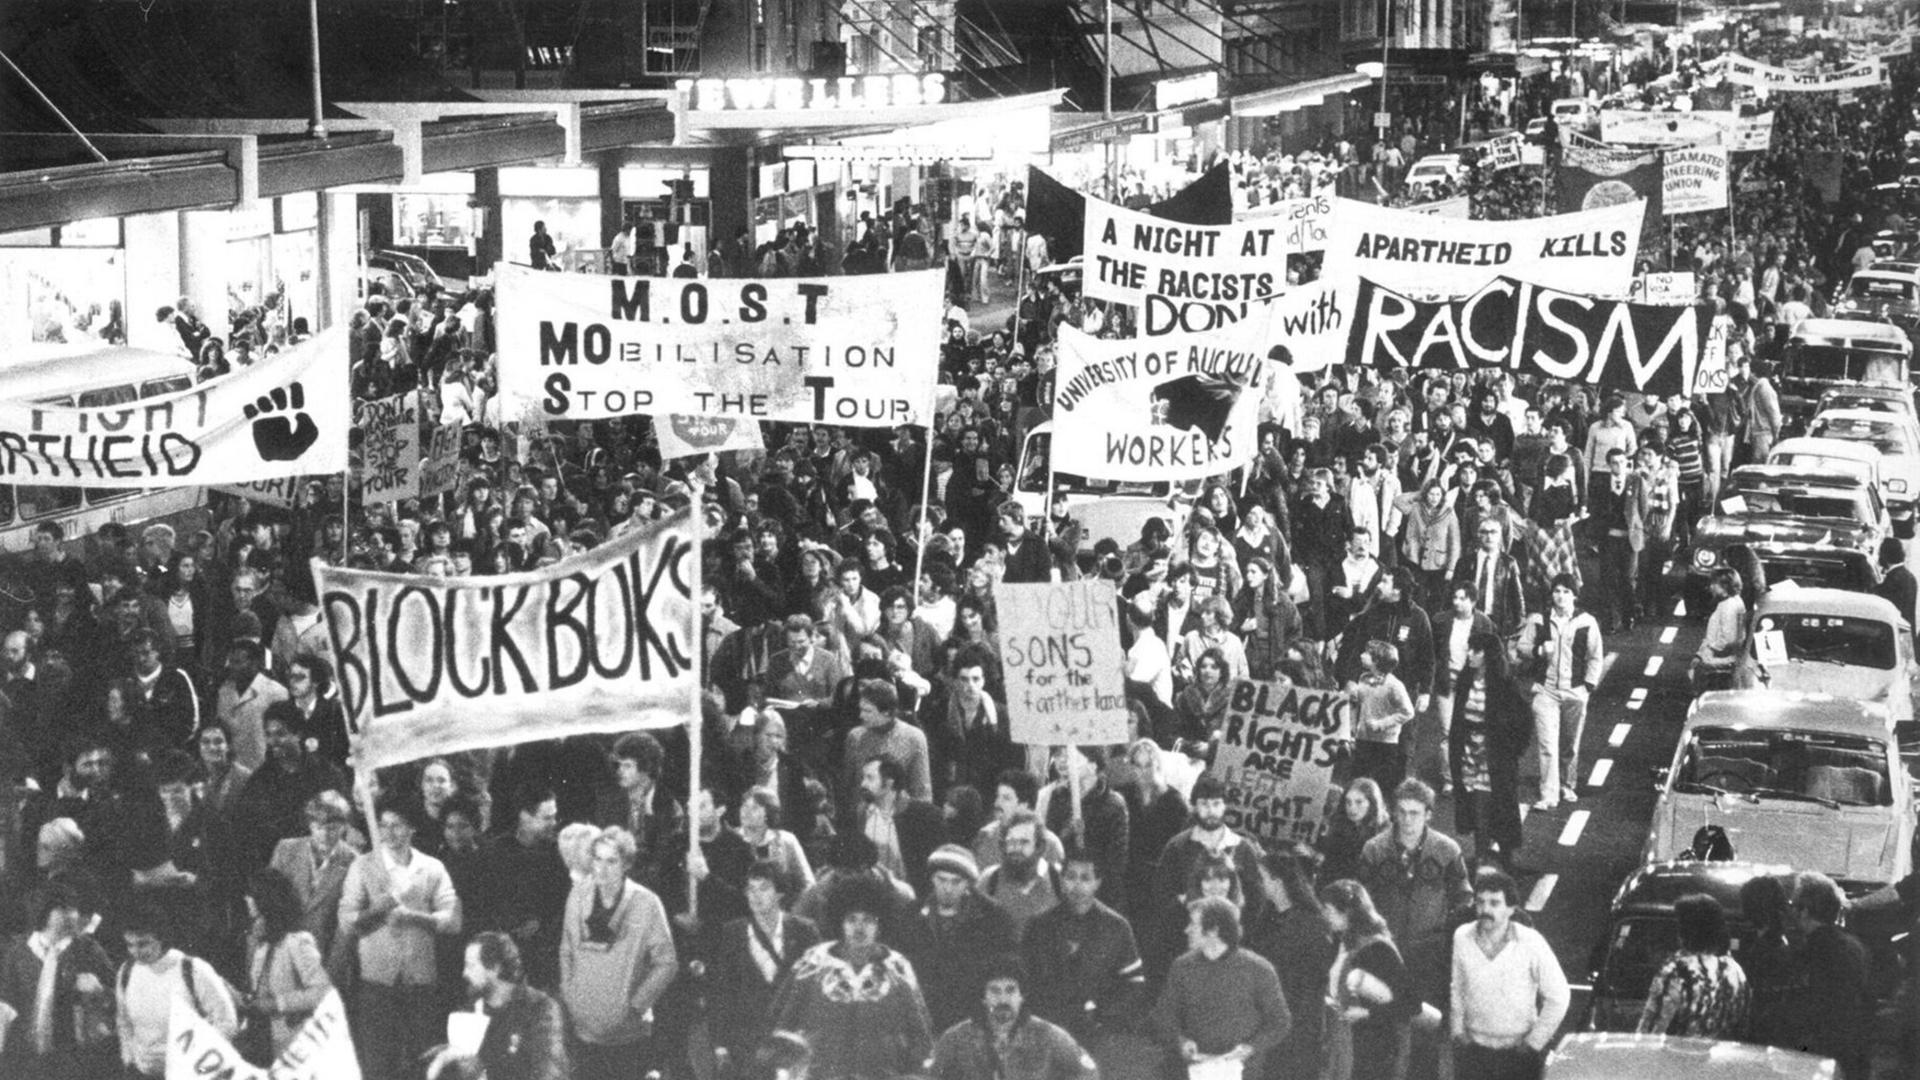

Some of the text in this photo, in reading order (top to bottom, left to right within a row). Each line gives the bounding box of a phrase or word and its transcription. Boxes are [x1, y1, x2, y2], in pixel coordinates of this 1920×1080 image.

[1764, 71, 1786, 82] PLAY
[1793, 74, 1819, 84] WITH
[1665, 179, 1702, 192] UNION
[1102, 218, 1275, 257] A NIGHT AT
[1355, 230, 1627, 266] APARTHEID KILLS
[1096, 254, 1273, 300] THE RACISTS
[1283, 289, 1341, 336] with
[540, 320, 895, 367] MOBILISATION
[1361, 277, 1699, 398] RACISM
[543, 372, 911, 422] STOP THE TOUR
[1057, 352, 1137, 412] UNIVERSITY
[1145, 350, 1178, 376] OF
[0, 431, 203, 479] RTHEID
[1106, 424, 1232, 467] WORKERS
[363, 467, 409, 495] TOUR
[322, 535, 692, 733] BLOCK BOKS
[1006, 633, 1093, 670] SONS
[1025, 668, 1092, 687] for the
[1231, 681, 1350, 735] BLACKS
[1226, 714, 1339, 768] RIGHTS
[1243, 752, 1294, 780] ARE
[1226, 788, 1313, 819] RIGHT
